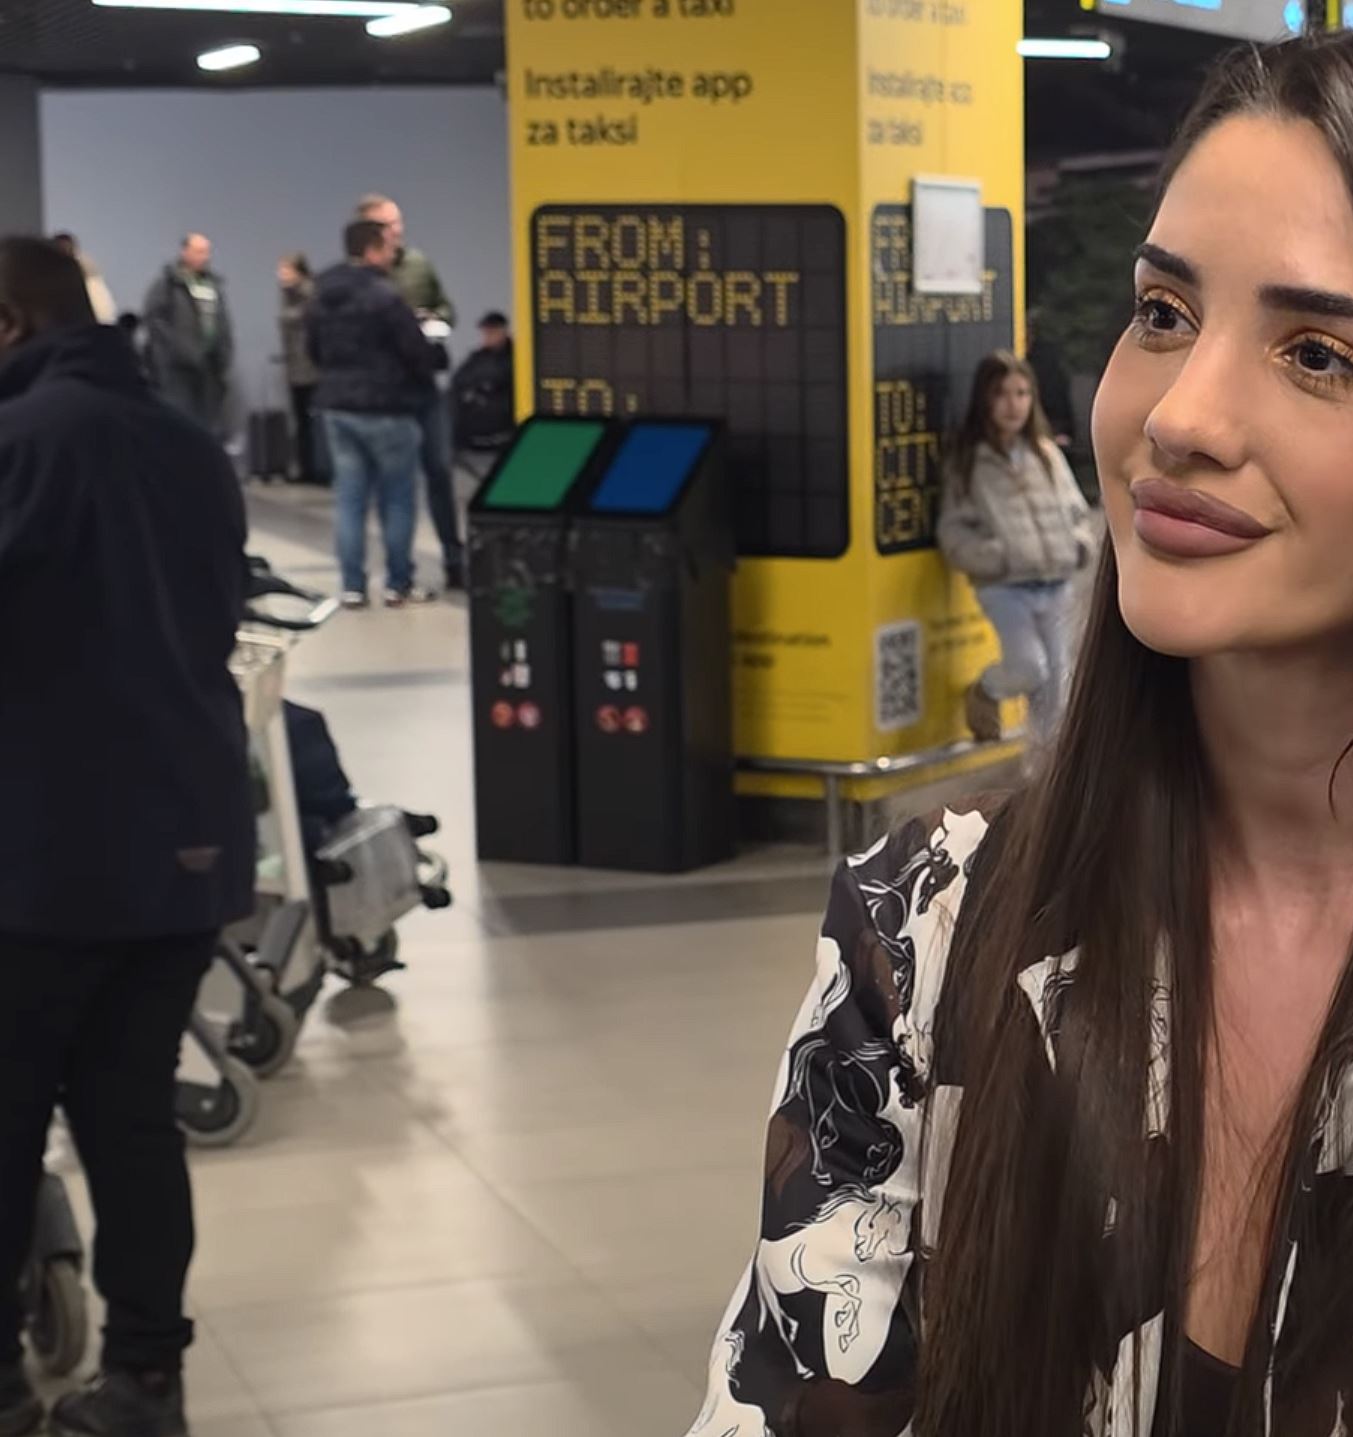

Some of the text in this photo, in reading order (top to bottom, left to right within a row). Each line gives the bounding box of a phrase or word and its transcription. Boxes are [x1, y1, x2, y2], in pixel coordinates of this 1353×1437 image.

[524, 0, 556, 20] to
[561, 0, 641, 19] order
[652, 0, 671, 18] a
[525, 69, 753, 106] Instalirajte app
[527, 115, 638, 146] za taksi
[538, 269, 800, 326] AIRPORT
